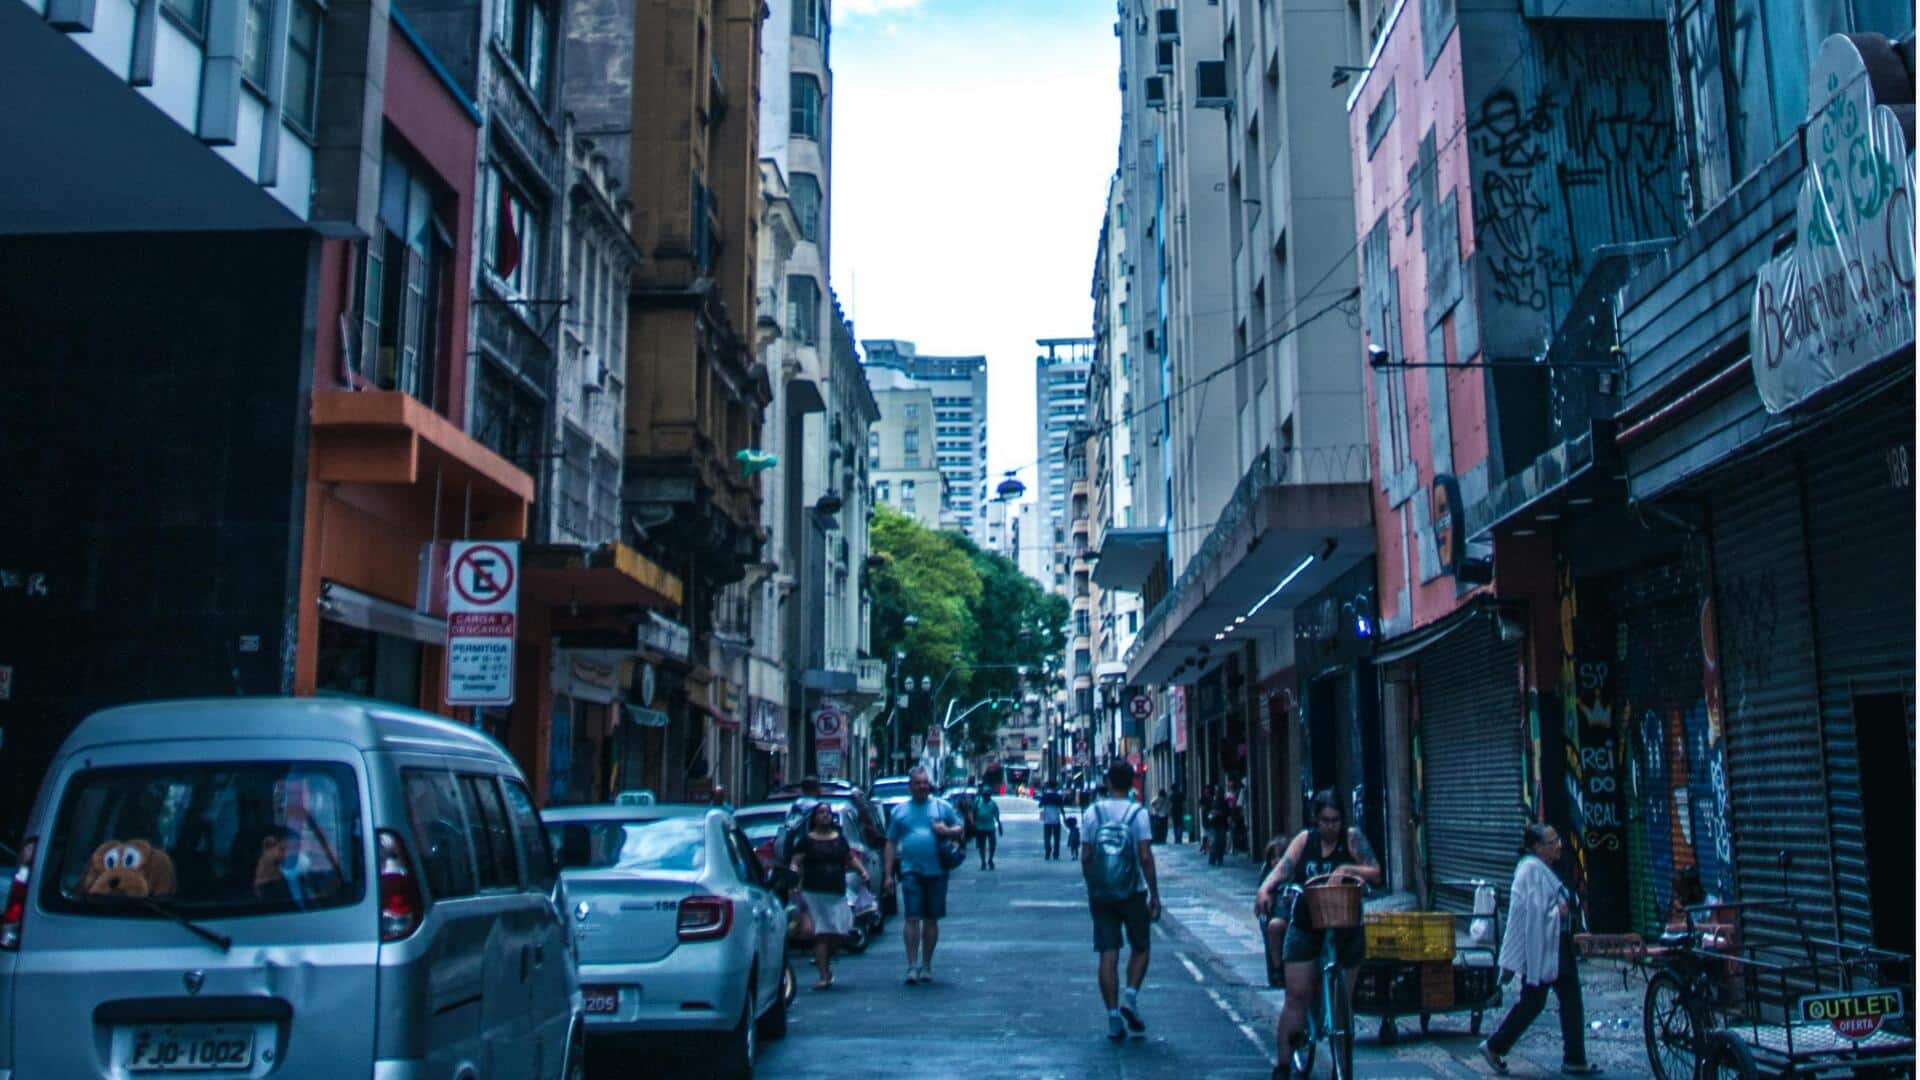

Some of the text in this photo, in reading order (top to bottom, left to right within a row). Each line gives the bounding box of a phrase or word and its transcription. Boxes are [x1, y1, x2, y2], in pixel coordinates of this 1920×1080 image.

[452, 644, 508, 653] PERMITIDA
[1590, 776, 1616, 793] DO
[1584, 802, 1622, 827] REAL
[1808, 995, 1892, 1018] OUTLET
[1839, 1018, 1874, 1031] OFERTA
